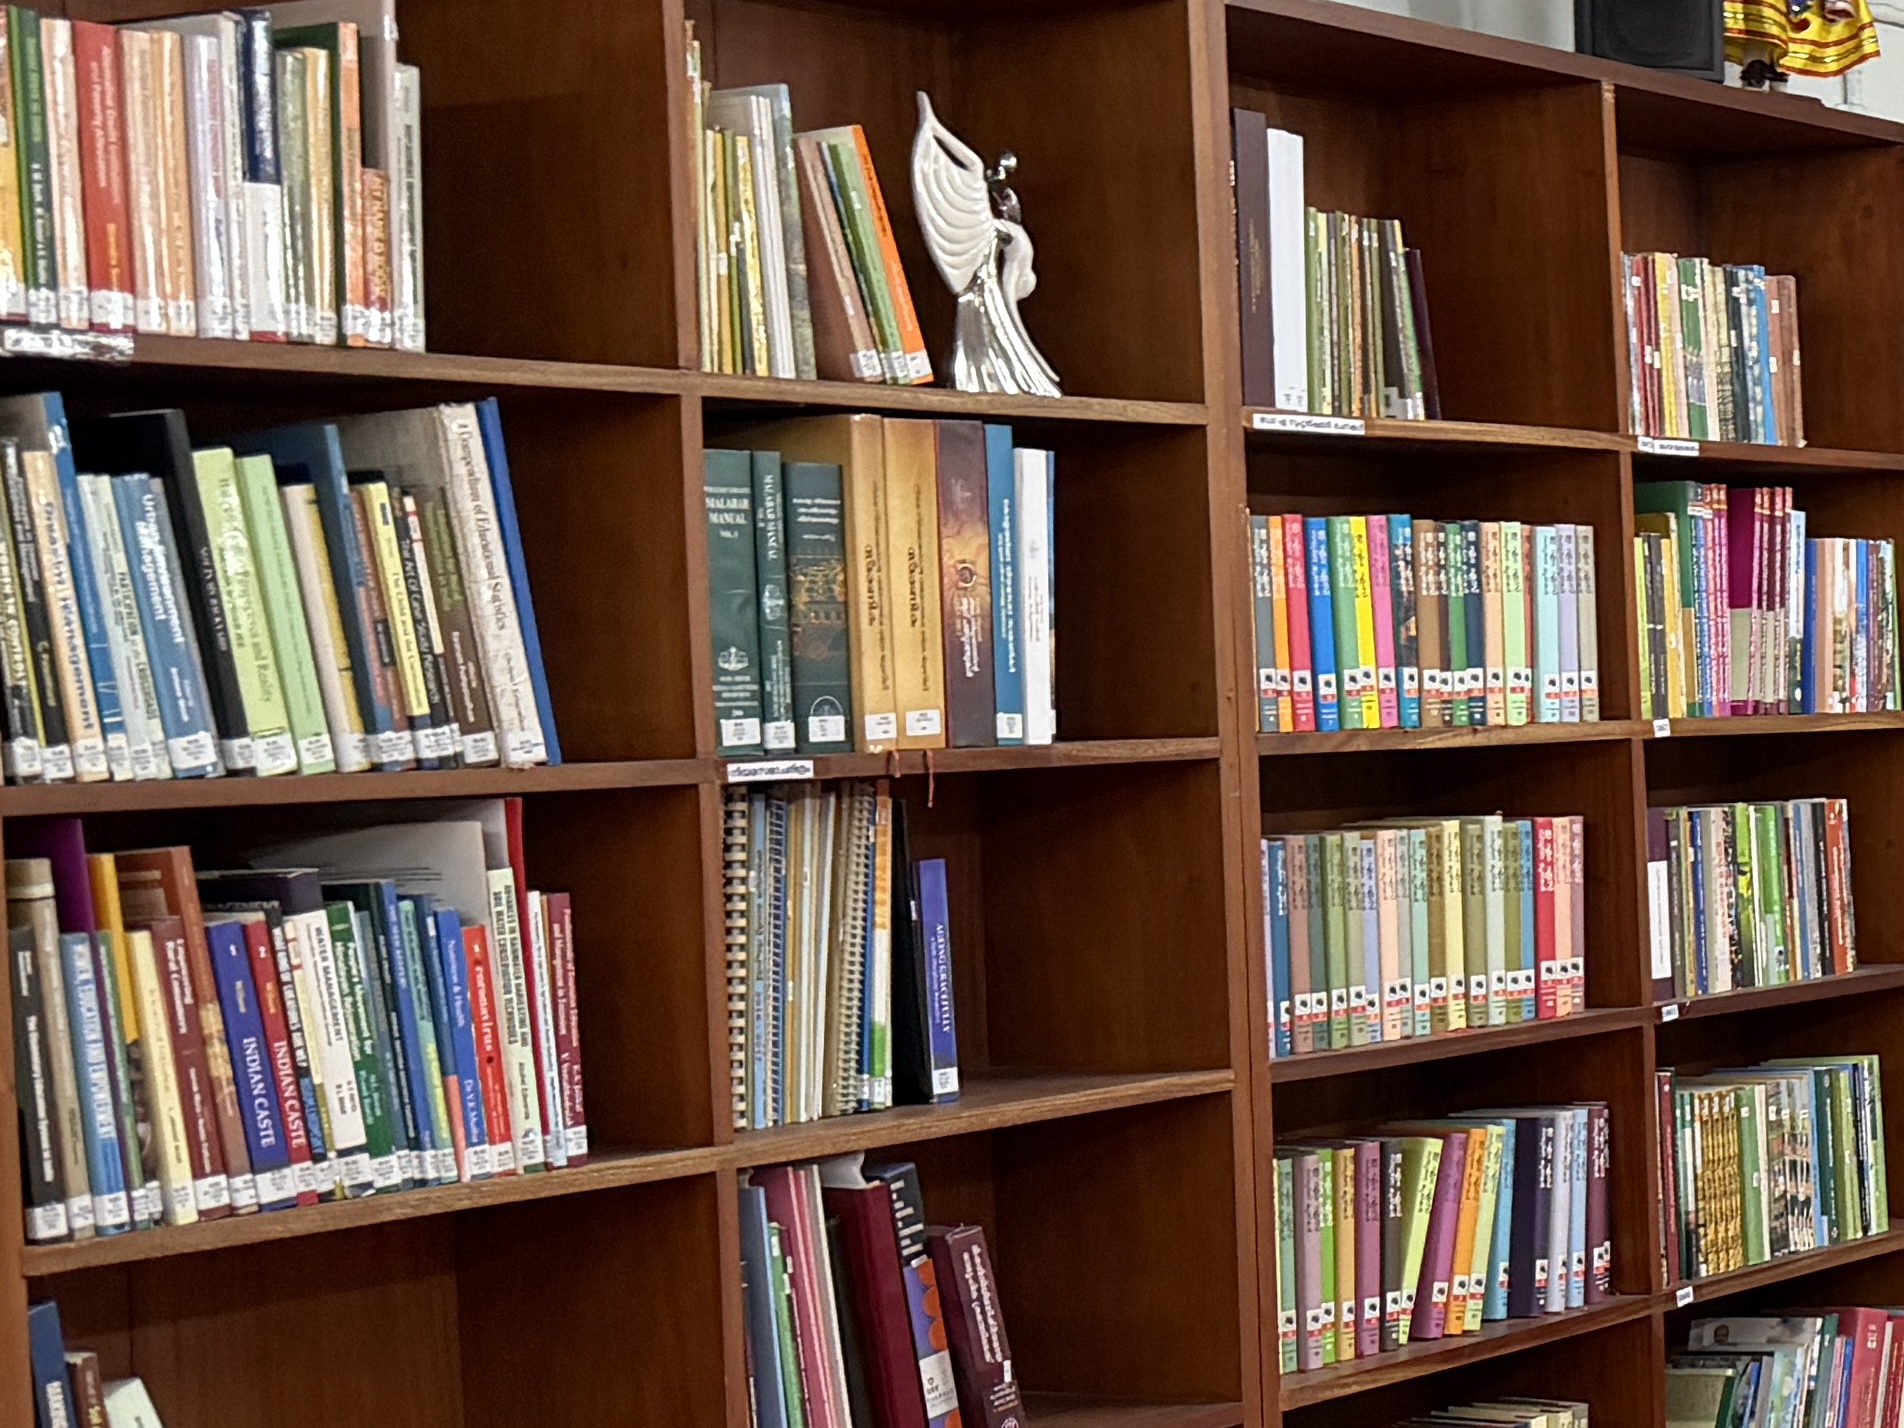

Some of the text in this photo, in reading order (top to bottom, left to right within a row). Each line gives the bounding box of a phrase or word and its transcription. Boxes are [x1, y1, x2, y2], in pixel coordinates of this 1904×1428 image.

[141, 493, 163, 542] Urban
[457, 431, 485, 503] Compendium
[472, 517, 499, 581] Educational
[488, 582, 509, 631] Statistics
[400, 539, 415, 559] The
[403, 561, 419, 578] Art
[77, 984, 103, 1039] EDUCATION
[314, 925, 344, 1043] WATER MANAGEMENT
[474, 964, 496, 1052] coronavirus
[241, 1036, 266, 1094] INDIAN
[273, 1040, 297, 1097] INDIAN
[88, 1064, 116, 1140] EMPOWERMENT
[253, 1096, 276, 1148] CASTE
[283, 1099, 305, 1149] CASTE
